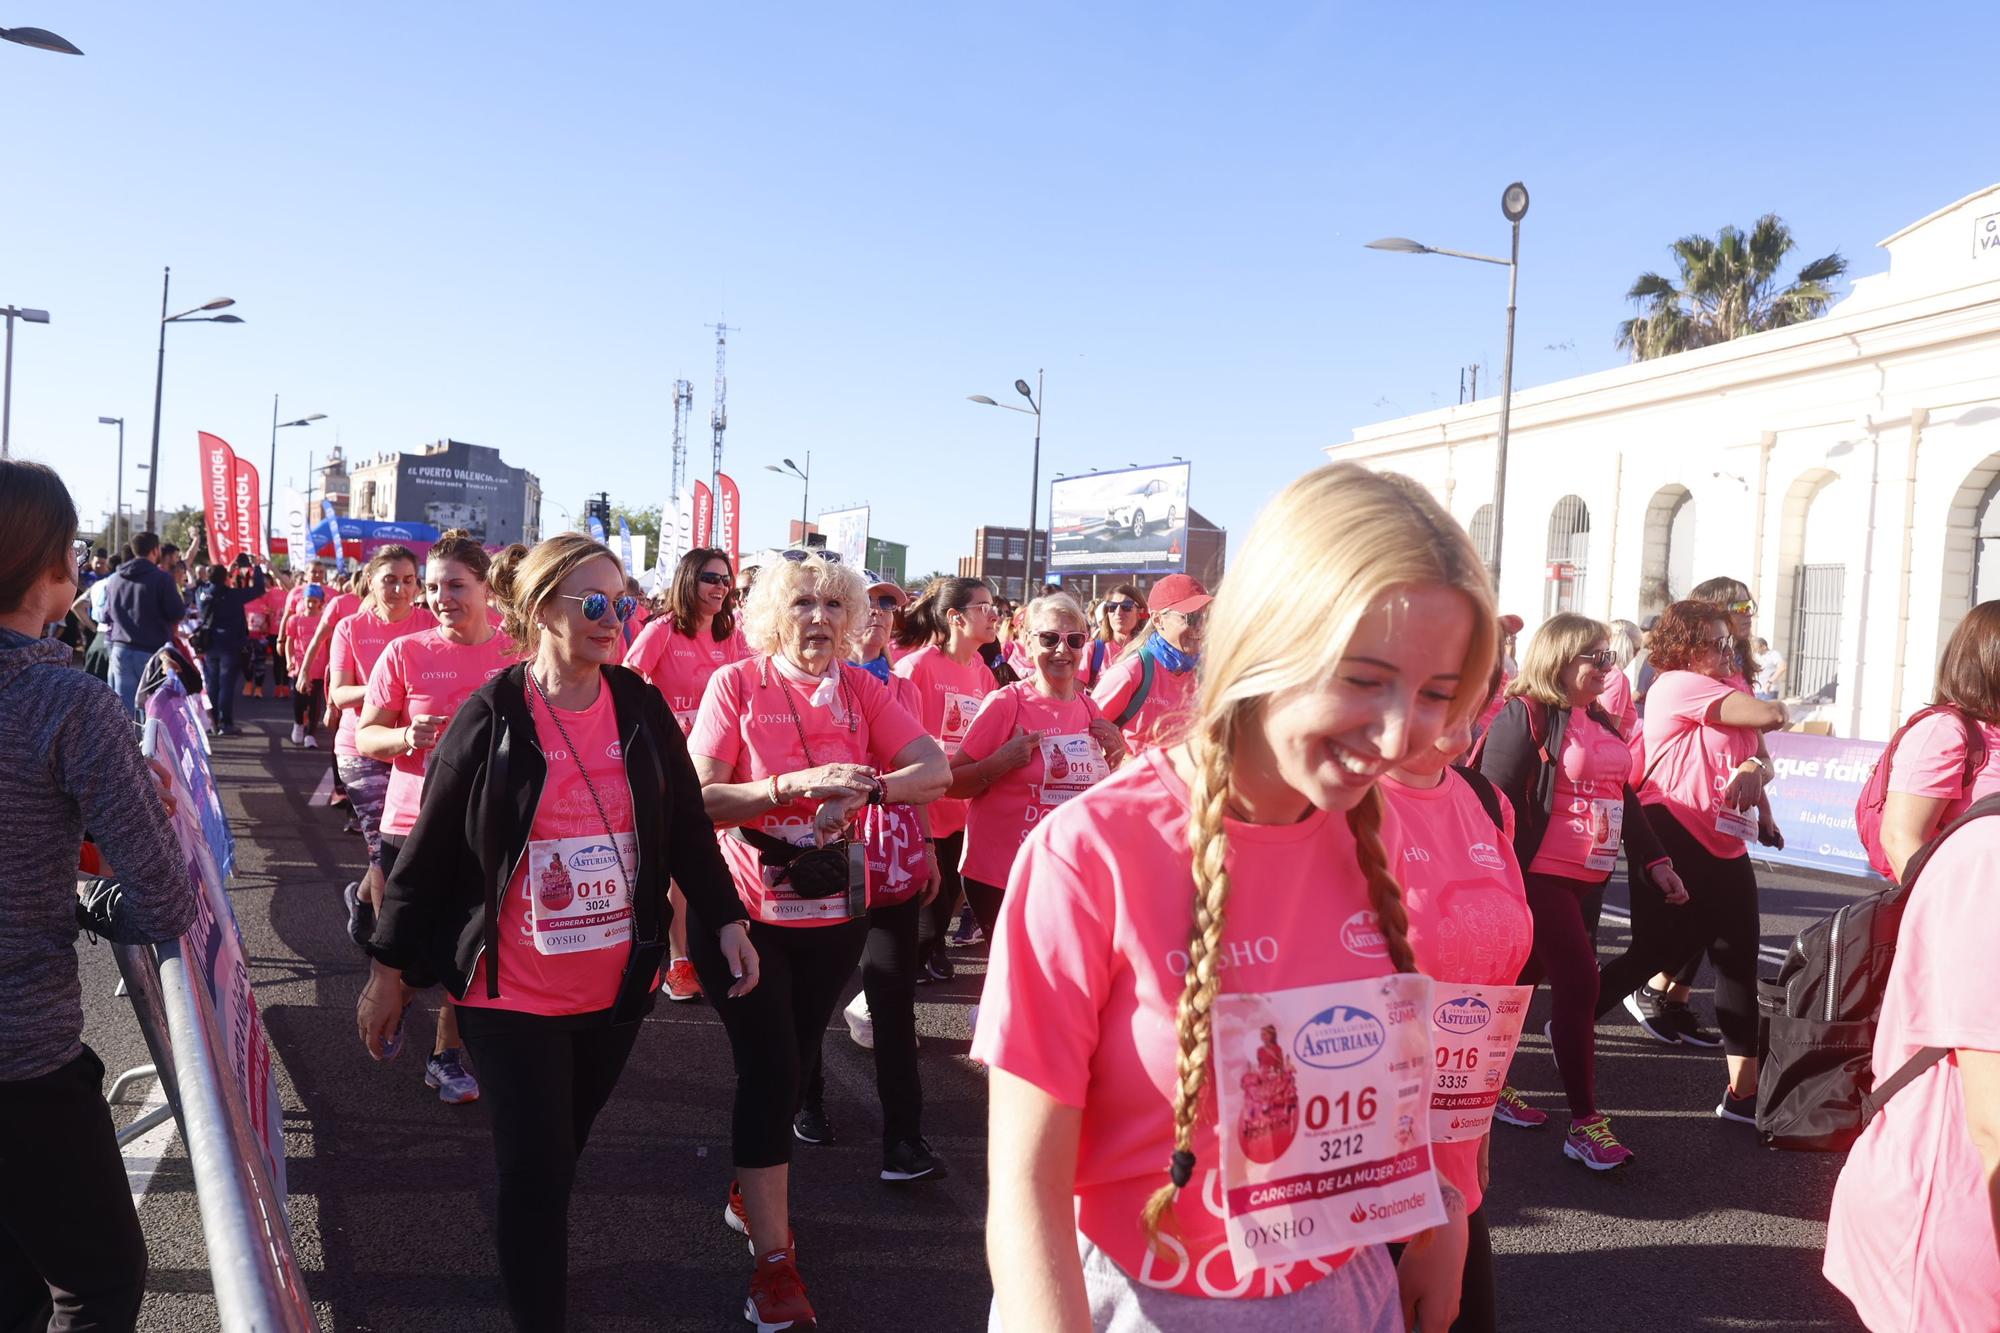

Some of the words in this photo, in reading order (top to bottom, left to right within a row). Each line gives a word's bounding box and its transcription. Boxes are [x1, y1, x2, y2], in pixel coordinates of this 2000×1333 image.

[419, 467, 452, 478] PUERTO
[421, 671, 457, 680] OYSHO
[674, 696, 692, 709] TU
[1070, 762, 1093, 773] 016
[1773, 758, 1820, 780] que
[573, 855, 616, 867] ASTURIANA
[577, 879, 617, 898] 016
[586, 899, 610, 911] 3024
[772, 905, 804, 914] OYSHO
[549, 919, 585, 928] CARRERA
[596, 914, 605, 923] LA
[547, 934, 586, 946] OYSHO
[1438, 1008, 1486, 1025] ASTURIANA
[1496, 1006, 1519, 1014] SUMA
[1303, 1031, 1379, 1057] ASTURIANA
[1436, 1046, 1479, 1070] 016
[1437, 1075, 1468, 1089] 3335
[1305, 1086, 1377, 1131] 016
[1432, 1097, 1444, 1105] DE
[1446, 1098, 1456, 1106] LA
[1457, 1097, 1481, 1106] MUJER
[1320, 1134, 1363, 1162] 3212
[1250, 1182, 1312, 1206] CARRERA
[1317, 1177, 1335, 1193] DE
[1337, 1173, 1352, 1188] LA
[1354, 1165, 1393, 1185] MUJER
[1395, 1155, 1417, 1174] 2023
[1369, 1192, 1426, 1220] Santander
[1244, 1216, 1314, 1249] OYSHO
